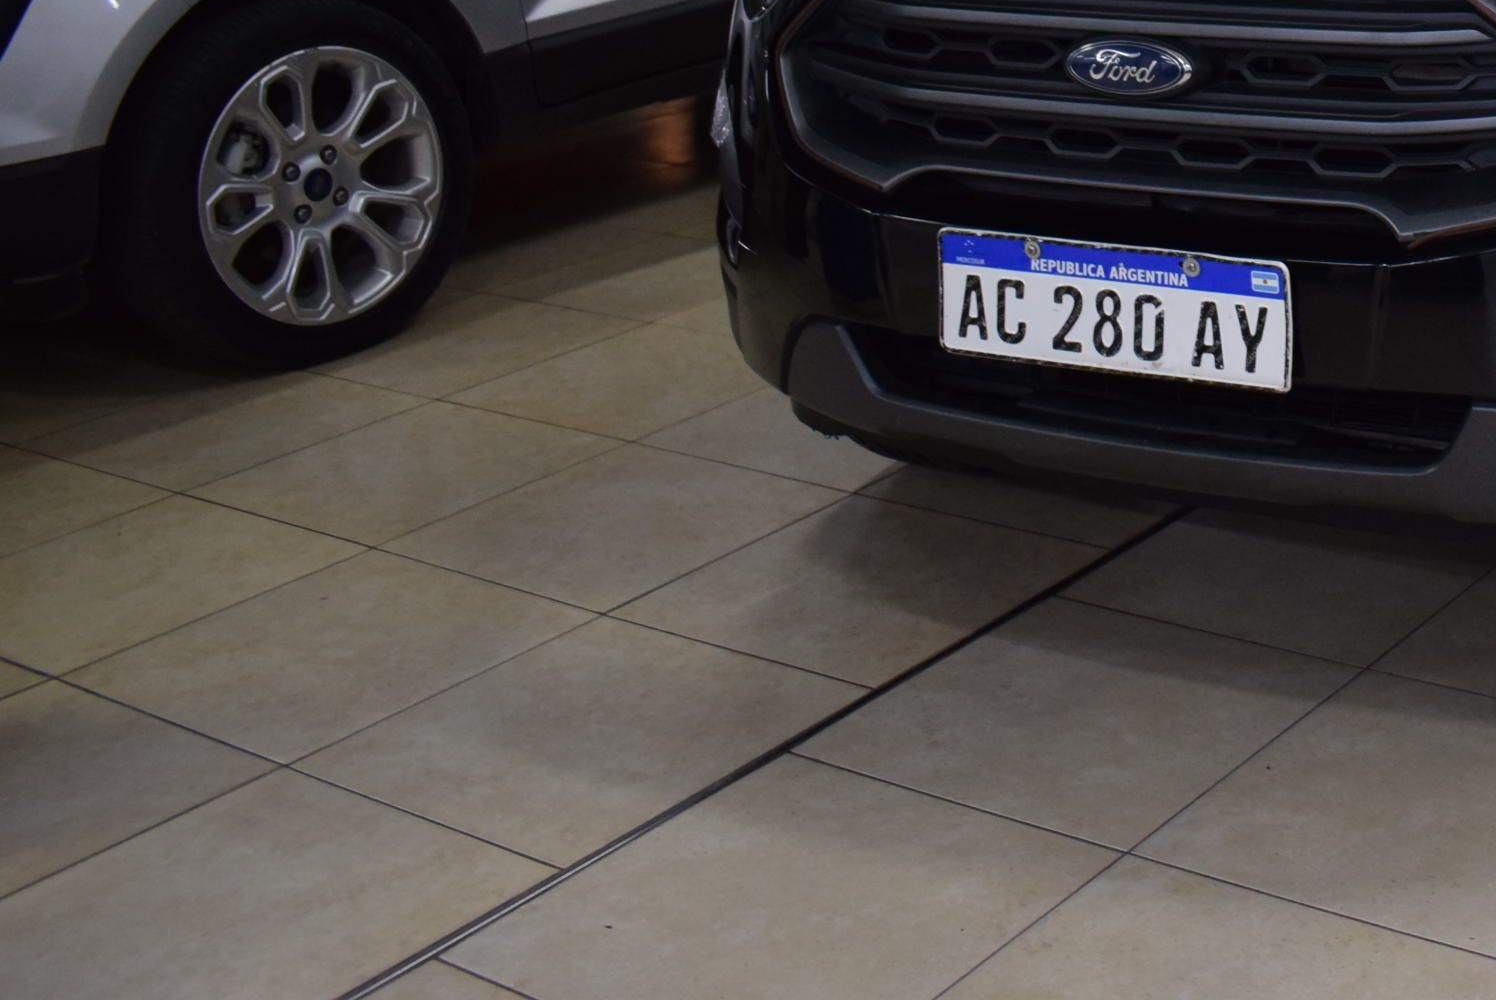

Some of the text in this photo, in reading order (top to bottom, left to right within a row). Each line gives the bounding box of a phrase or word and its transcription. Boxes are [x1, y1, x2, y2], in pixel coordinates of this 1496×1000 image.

[1089, 48, 1158, 84] Ford
[1030, 258, 1189, 288] REPUBLICA ARGENTINA
[958, 274, 1268, 374] AC 280 AY
